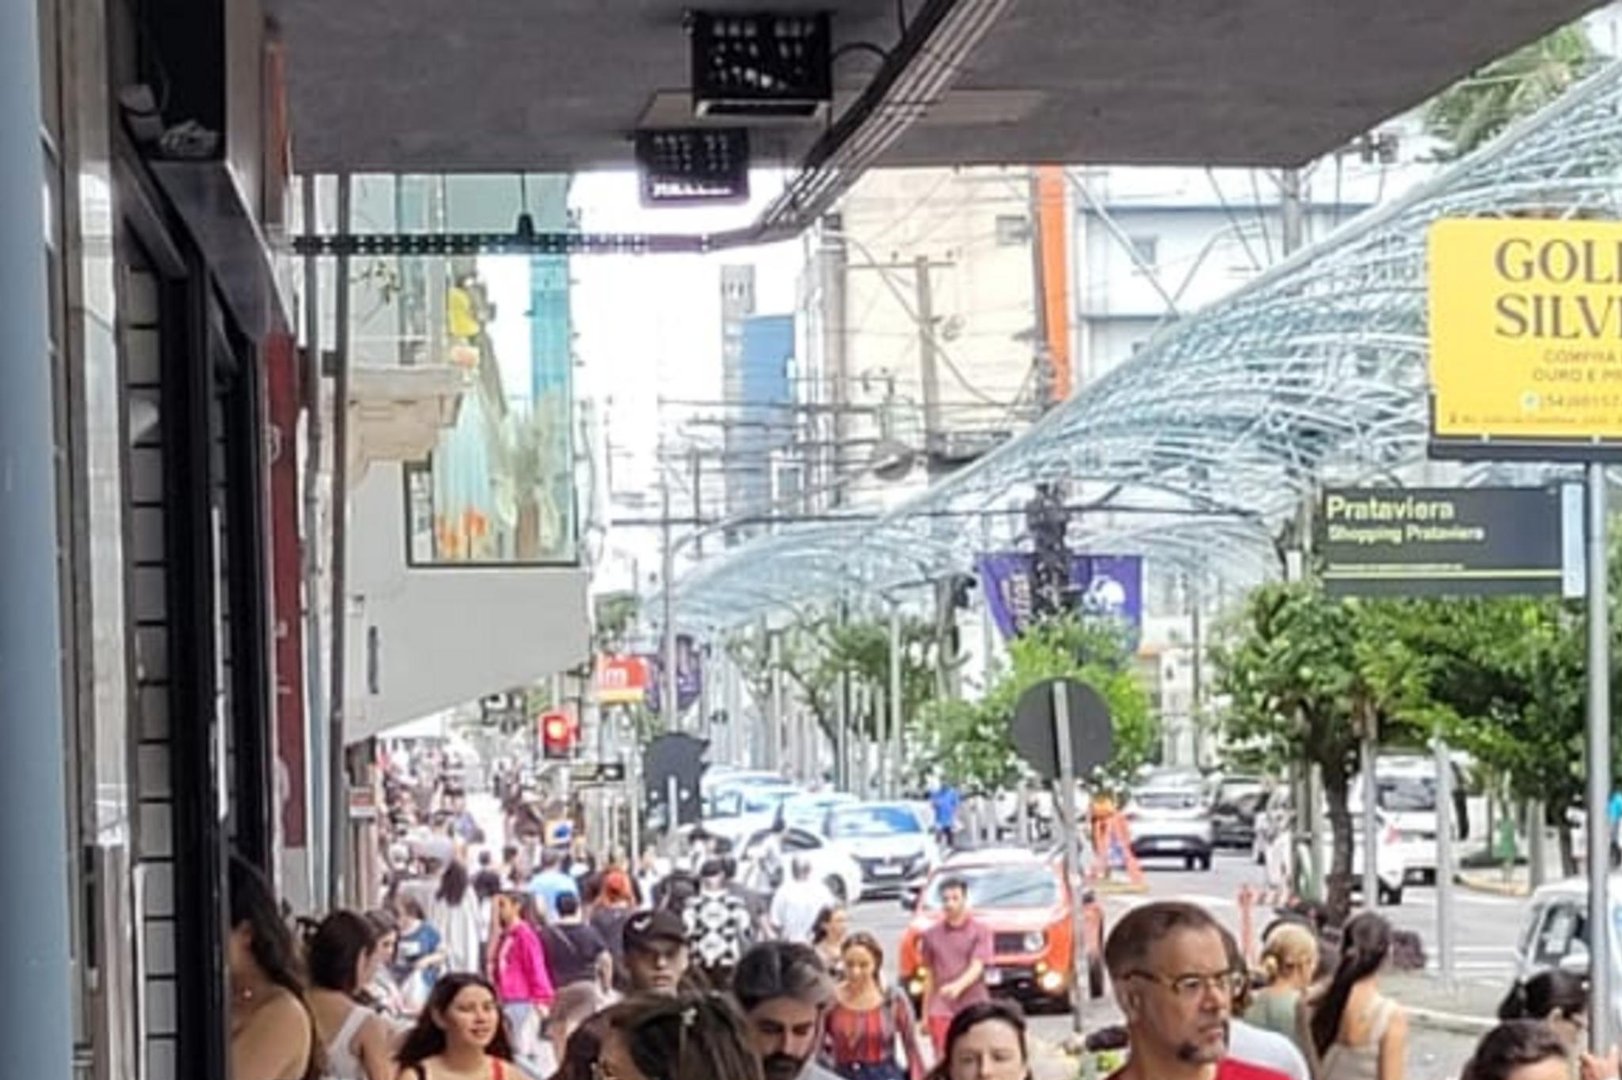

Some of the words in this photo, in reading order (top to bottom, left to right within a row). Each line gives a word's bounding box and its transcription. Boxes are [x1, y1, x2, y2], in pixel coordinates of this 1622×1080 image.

[1533, 367, 1582, 382] OURO
[1587, 367, 1595, 383] E
[1327, 495, 1455, 520] Prataviera
[1328, 524, 1402, 544] Shopping
[1406, 523, 1485, 542] Prataviera
